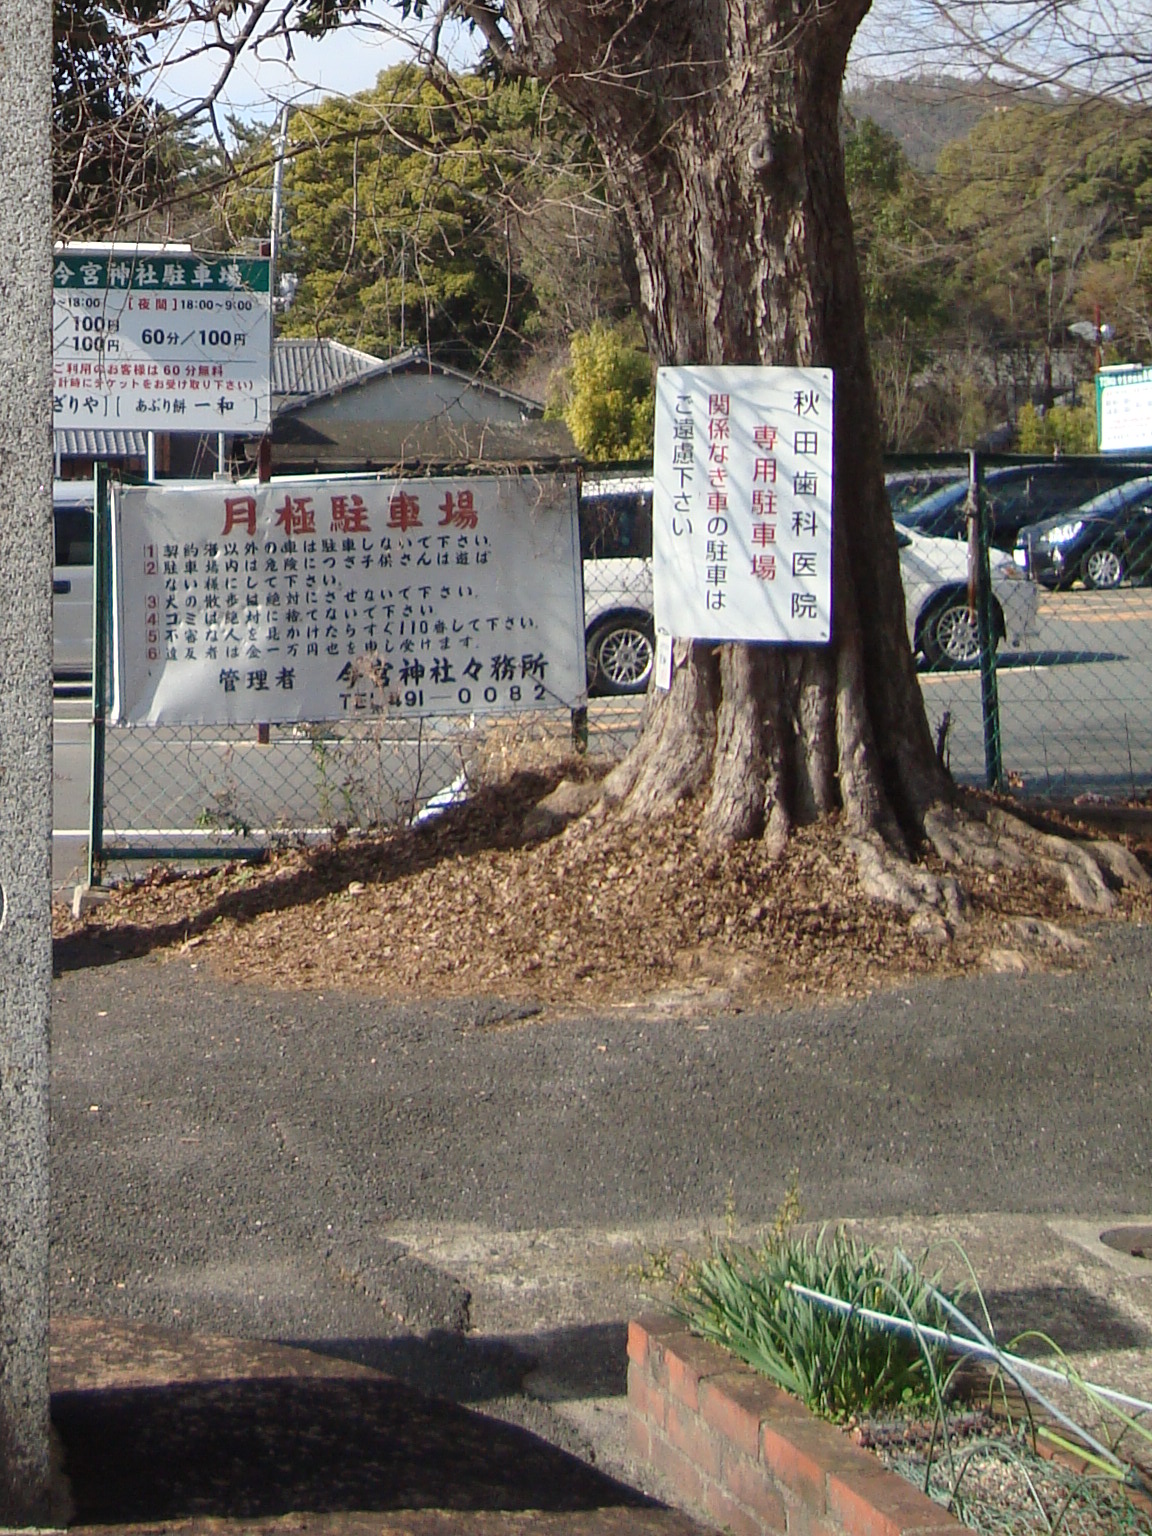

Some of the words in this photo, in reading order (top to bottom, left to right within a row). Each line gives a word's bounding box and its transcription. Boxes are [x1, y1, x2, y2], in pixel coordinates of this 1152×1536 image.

[54, 260, 244, 288] 今宮神社駐車場
[53, 377, 254, 392] 計時にチケットをお受け取り下さい)
[220, 489, 480, 536] 月極駐車場
[672, 394, 695, 537] ご遠慮下さい
[705, 393, 731, 611] 関係なき車の駐車は
[750, 424, 779, 581] 専用駐車場
[790, 389, 820, 620] 秋田歯科医院
[219, 667, 298, 694] 管理者
